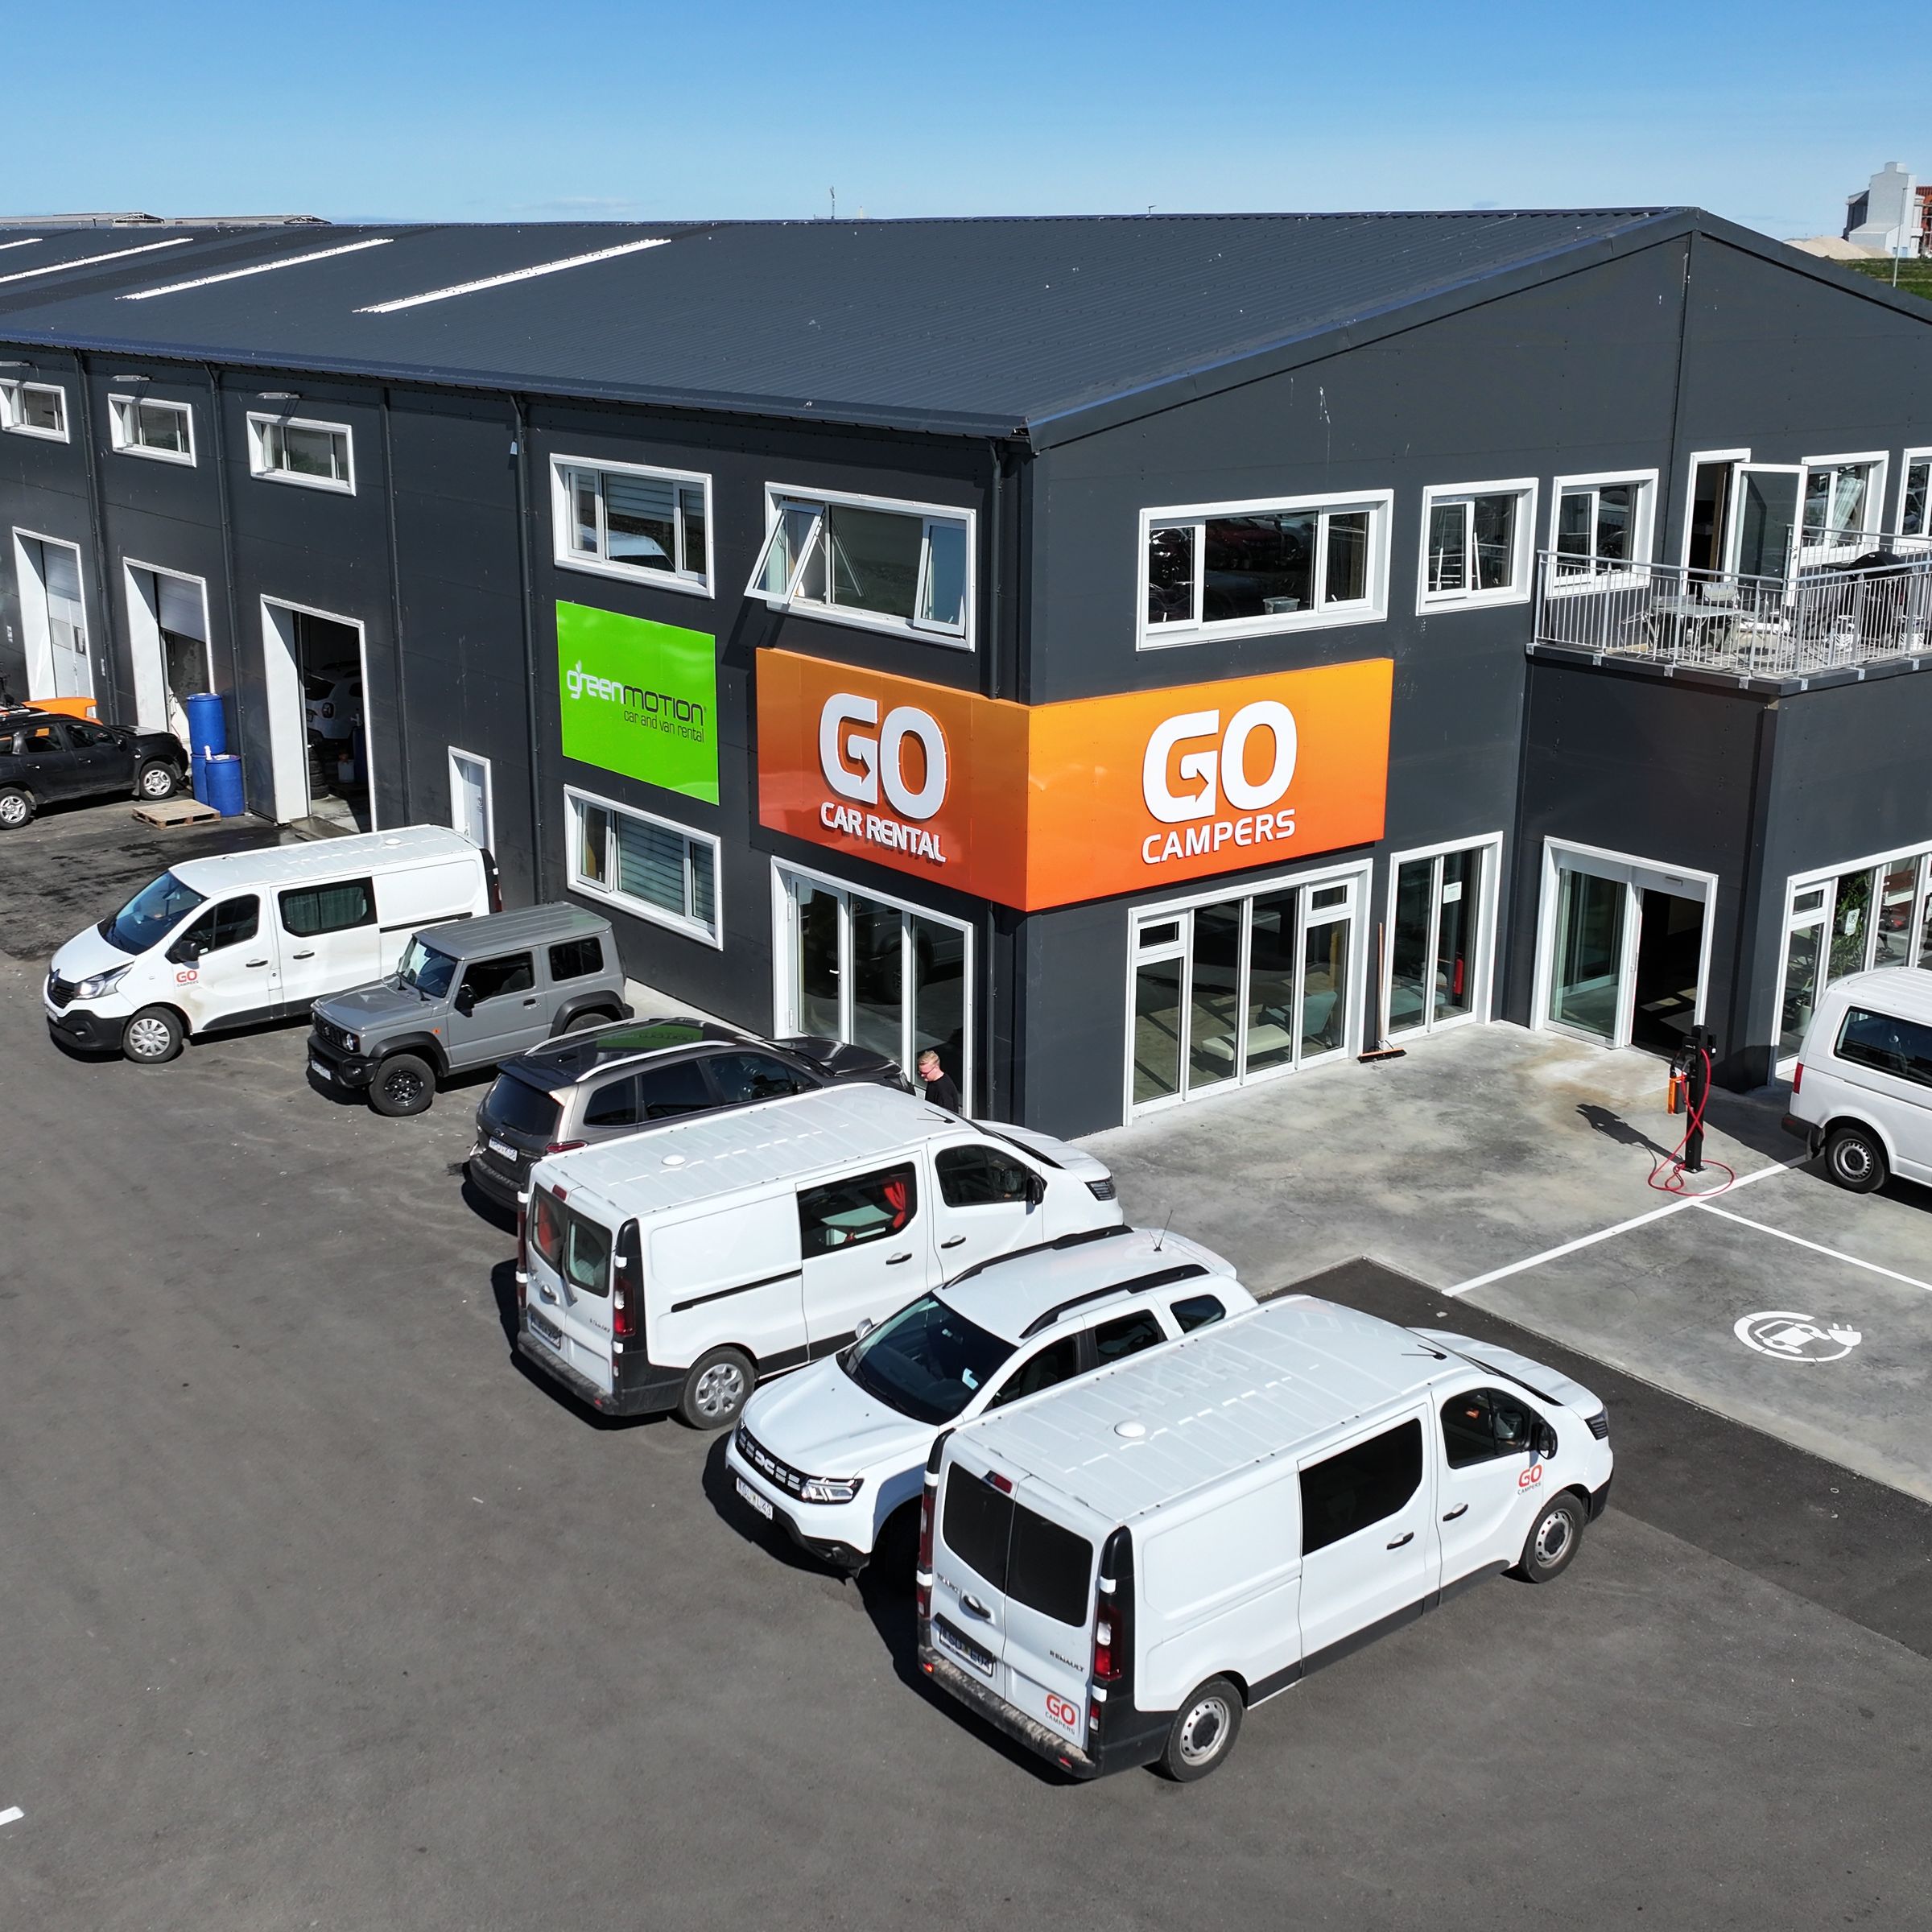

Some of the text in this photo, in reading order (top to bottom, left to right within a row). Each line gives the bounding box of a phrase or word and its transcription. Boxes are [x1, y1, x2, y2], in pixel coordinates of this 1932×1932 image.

[624, 710, 704, 742] car and van rental
[819, 692, 947, 819] GO
[1142, 700, 1298, 824] GO
[821, 802, 947, 863] CAR RENTAL
[1141, 808, 1296, 865] CAMPERS
[176, 970, 197, 982] GO
[1519, 1464, 1542, 1487] GO
[1050, 1649, 1084, 1672] RENAULT
[1046, 1694, 1075, 1726] GO
[1046, 1711, 1075, 1736] CAMPERS
